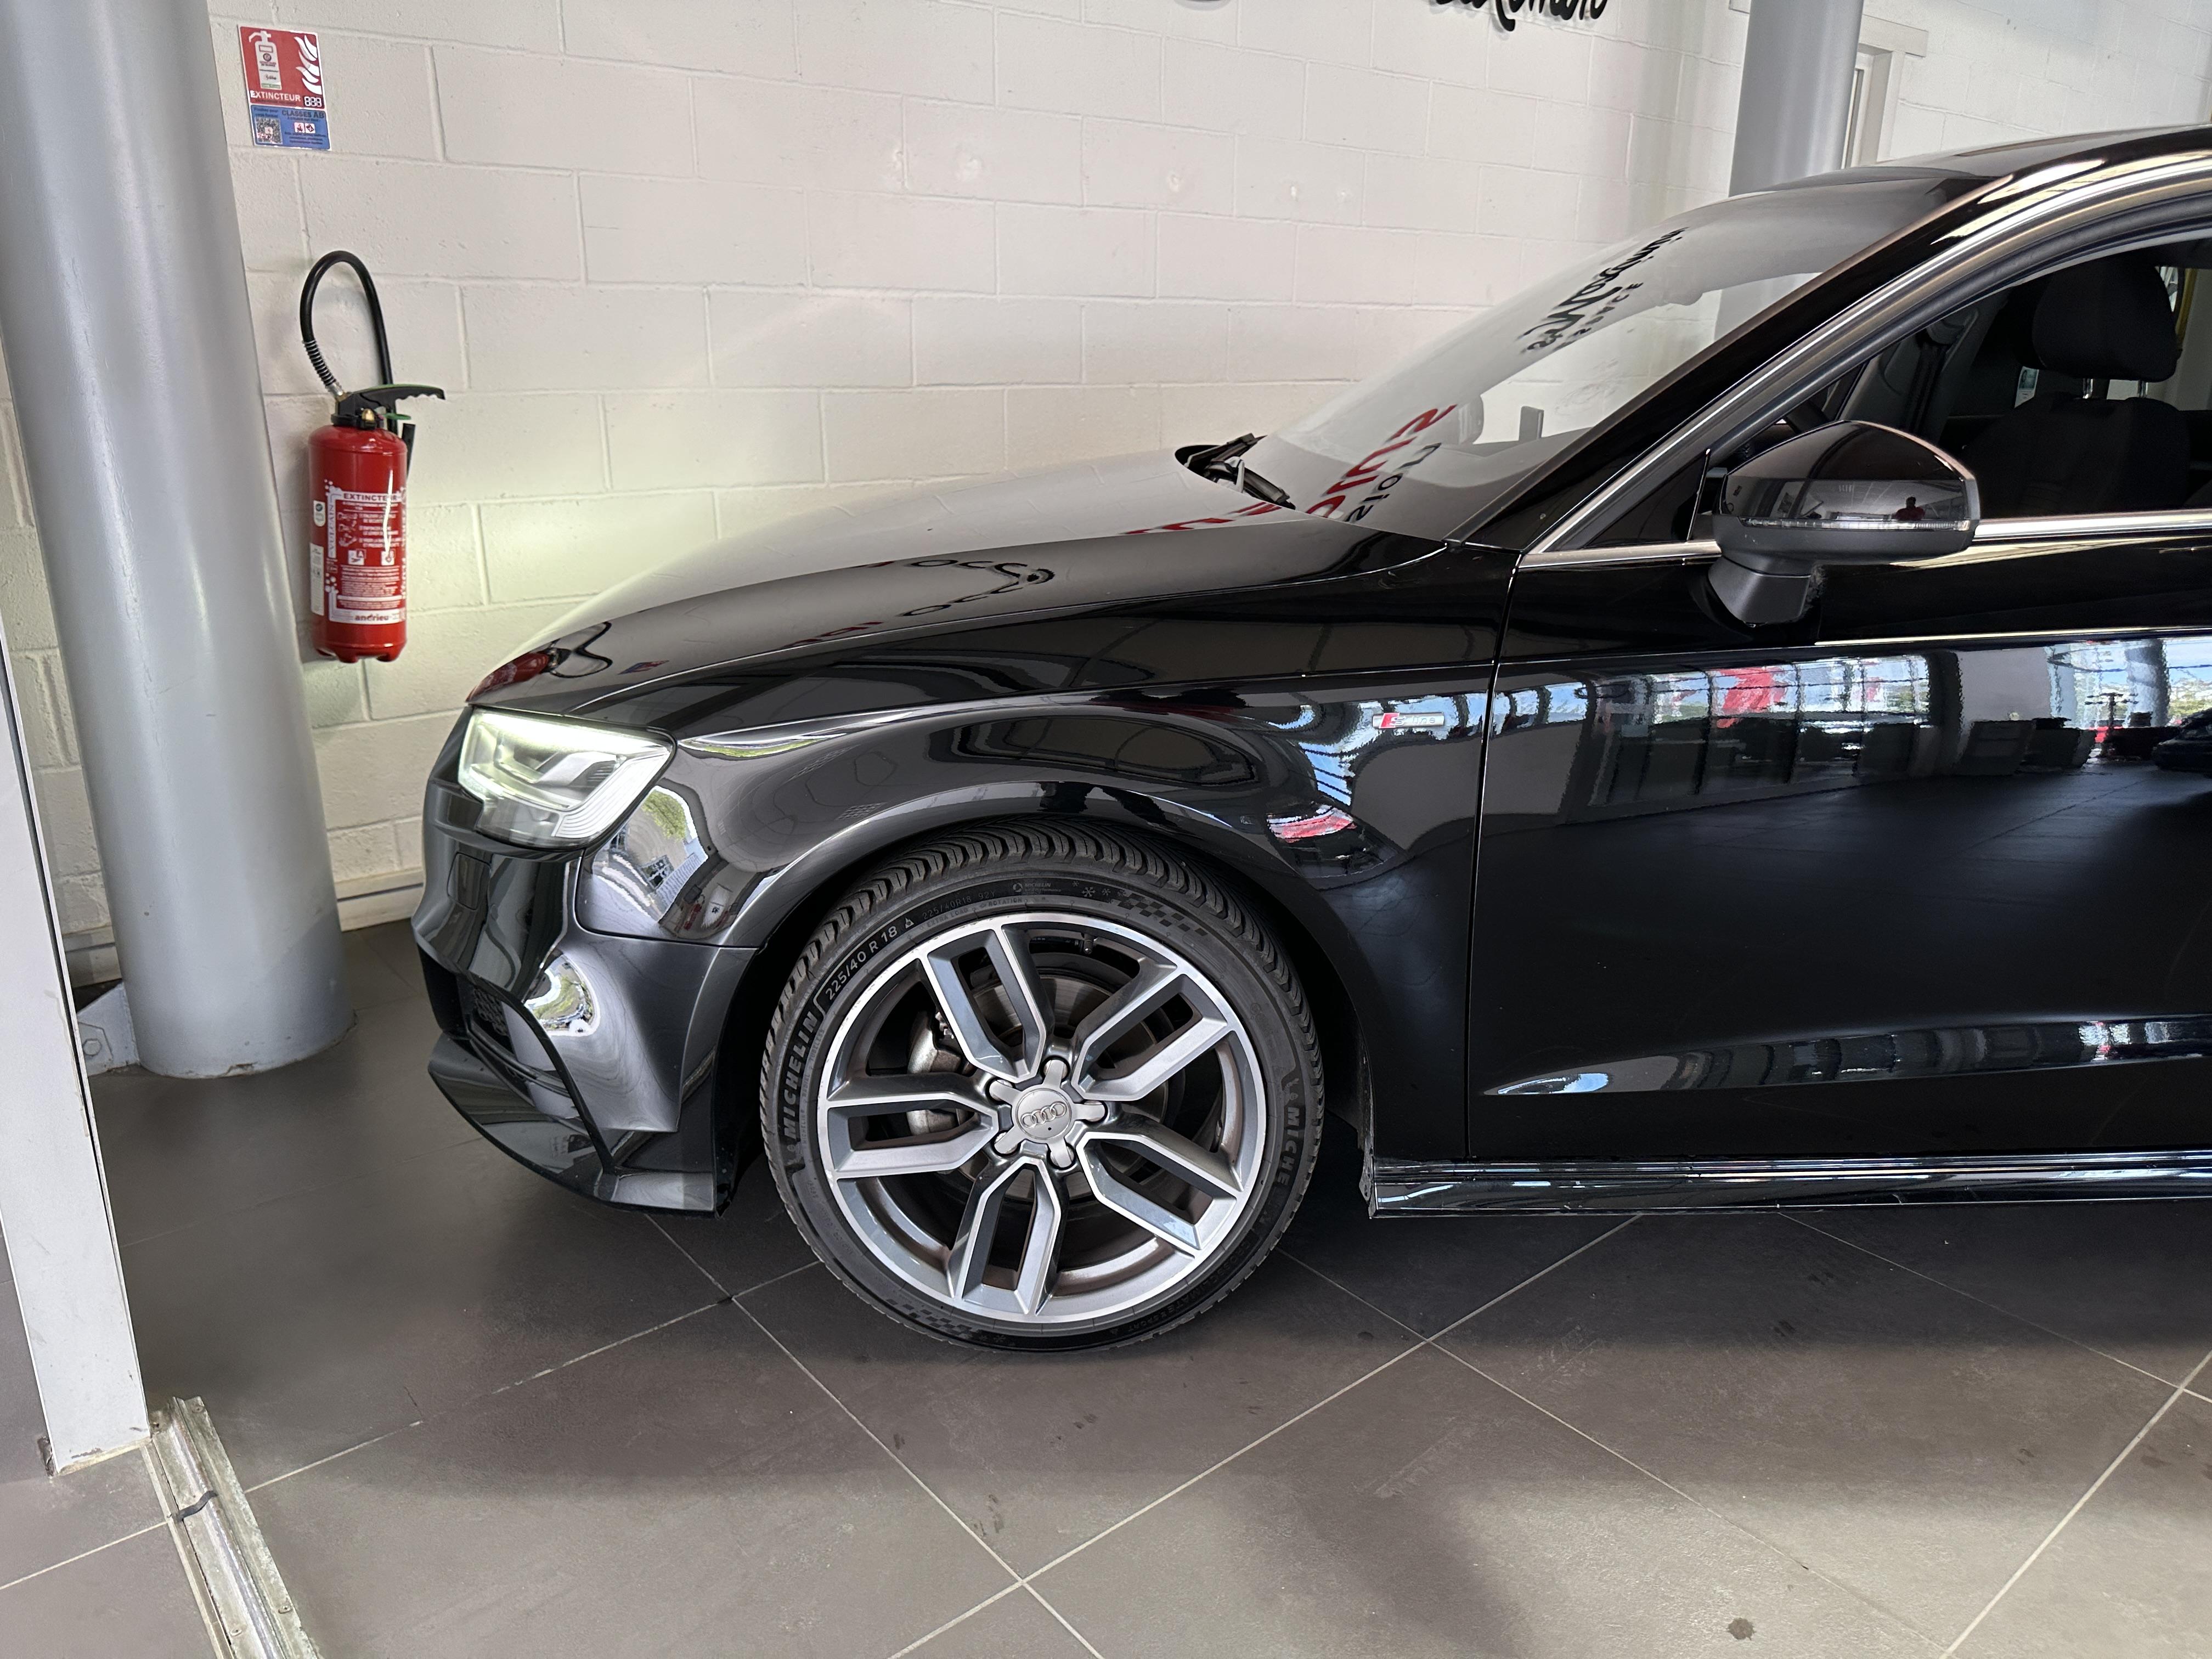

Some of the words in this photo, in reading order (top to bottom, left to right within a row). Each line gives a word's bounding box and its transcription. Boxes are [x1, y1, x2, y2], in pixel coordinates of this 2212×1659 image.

[250, 91, 301, 101] EXTINCTEUR
[922, 896, 972, 919] 225/40R18
[977, 889, 996, 900] 92Y
[825, 951, 867, 1000] 225/40
[867, 940, 880, 953] R
[881, 925, 899, 943] 18
[783, 1011, 821, 1141] MICHELIN
